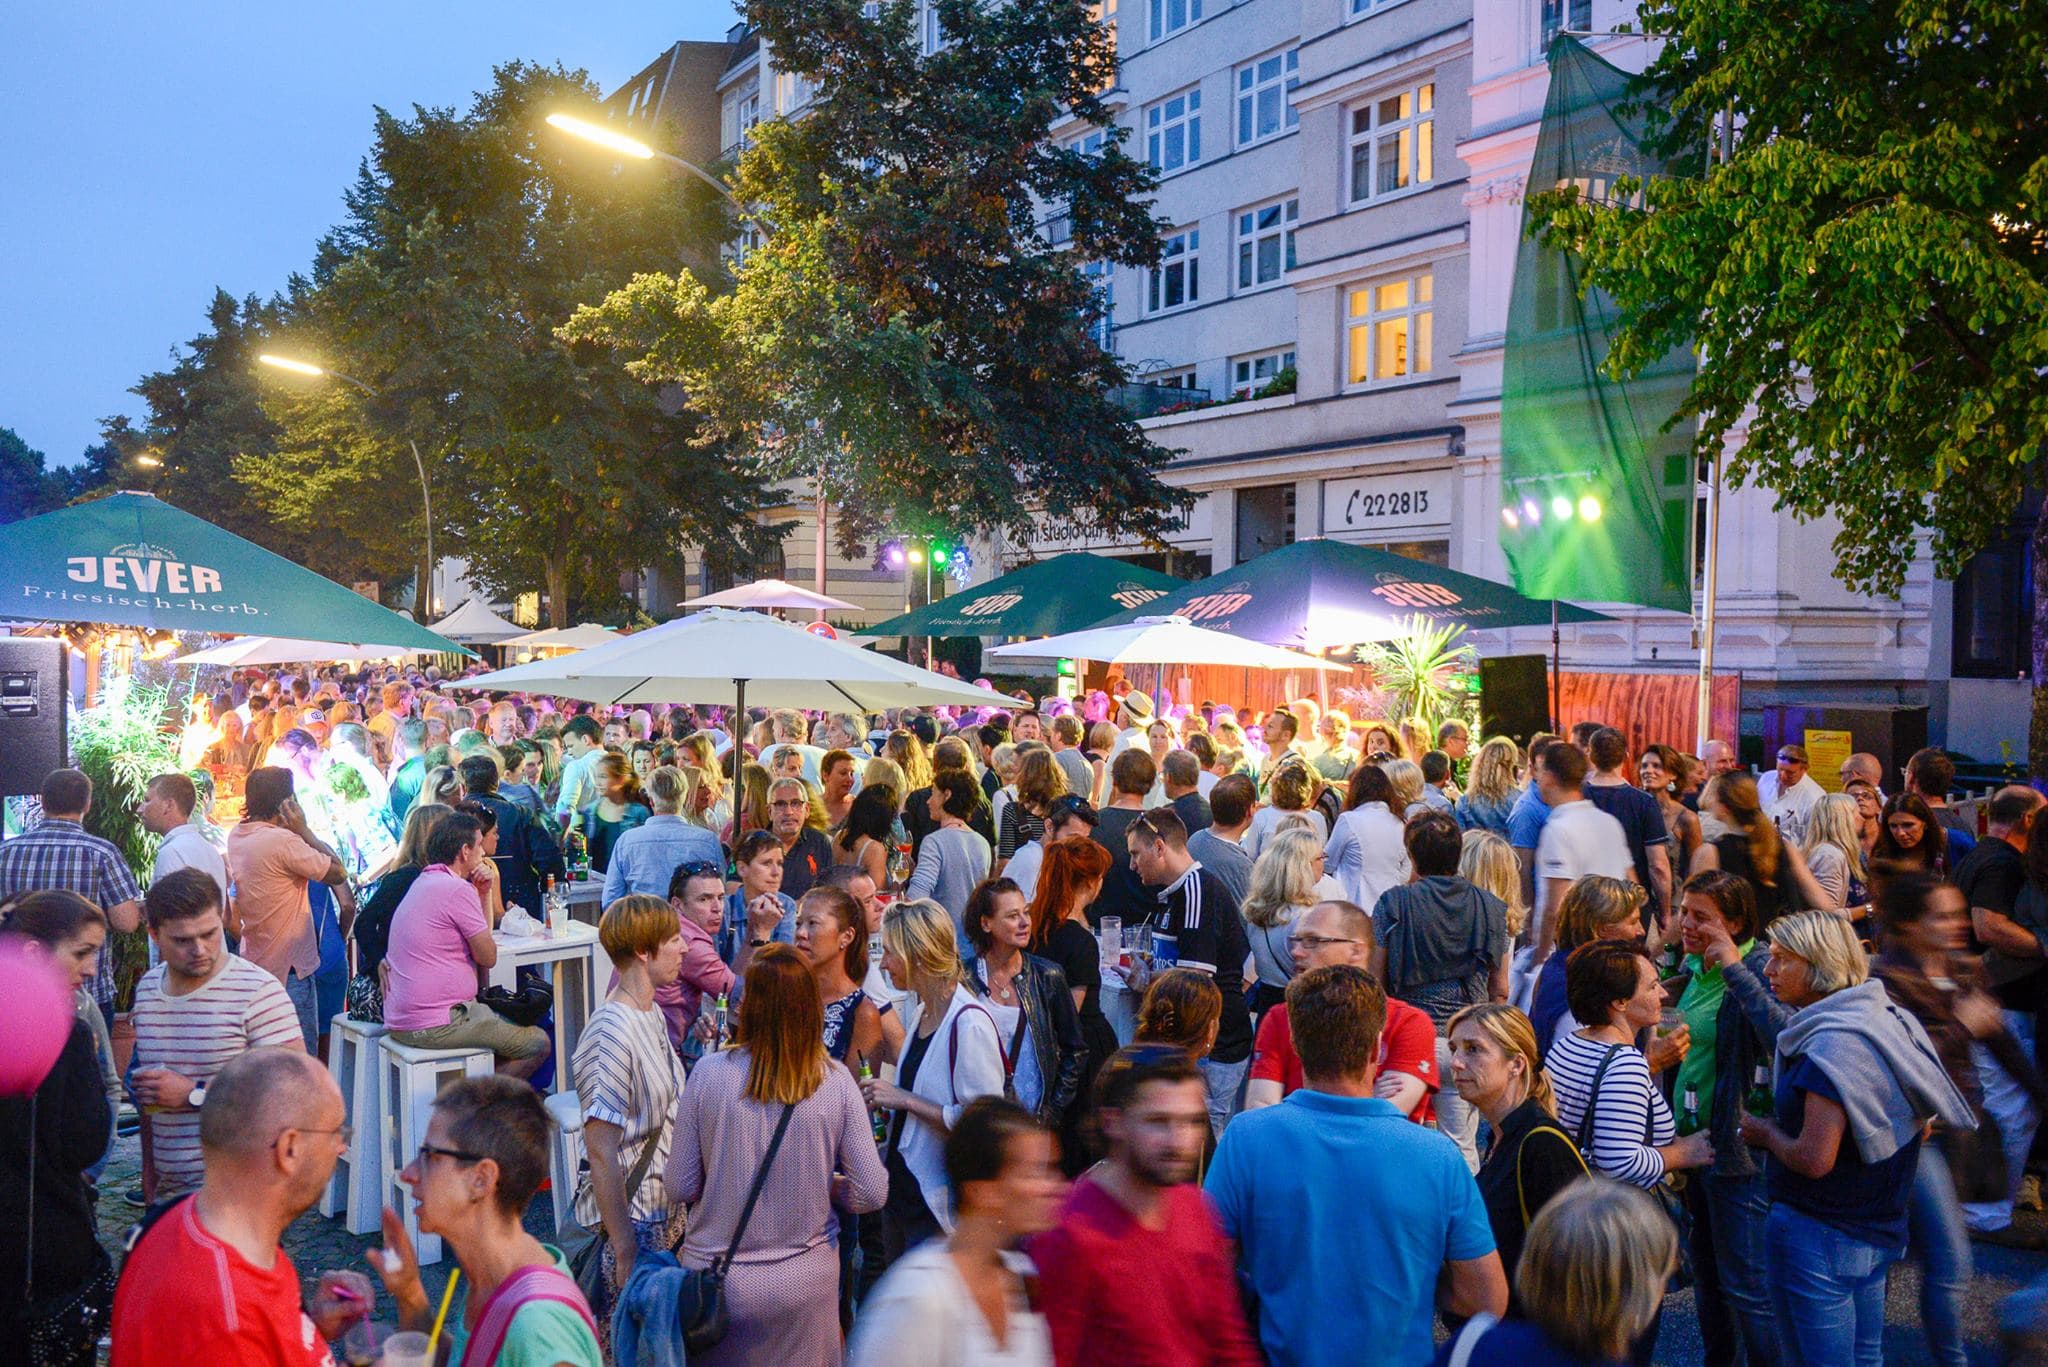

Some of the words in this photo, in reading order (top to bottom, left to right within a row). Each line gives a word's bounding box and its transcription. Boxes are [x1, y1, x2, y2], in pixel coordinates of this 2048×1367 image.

[67, 557, 222, 593] JEVER
[24, 586, 269, 616] Friesisch-herb.
[960, 594, 1023, 616] JEVER
[1173, 593, 1253, 621] JEVER
[1371, 582, 1463, 608] JEVER
